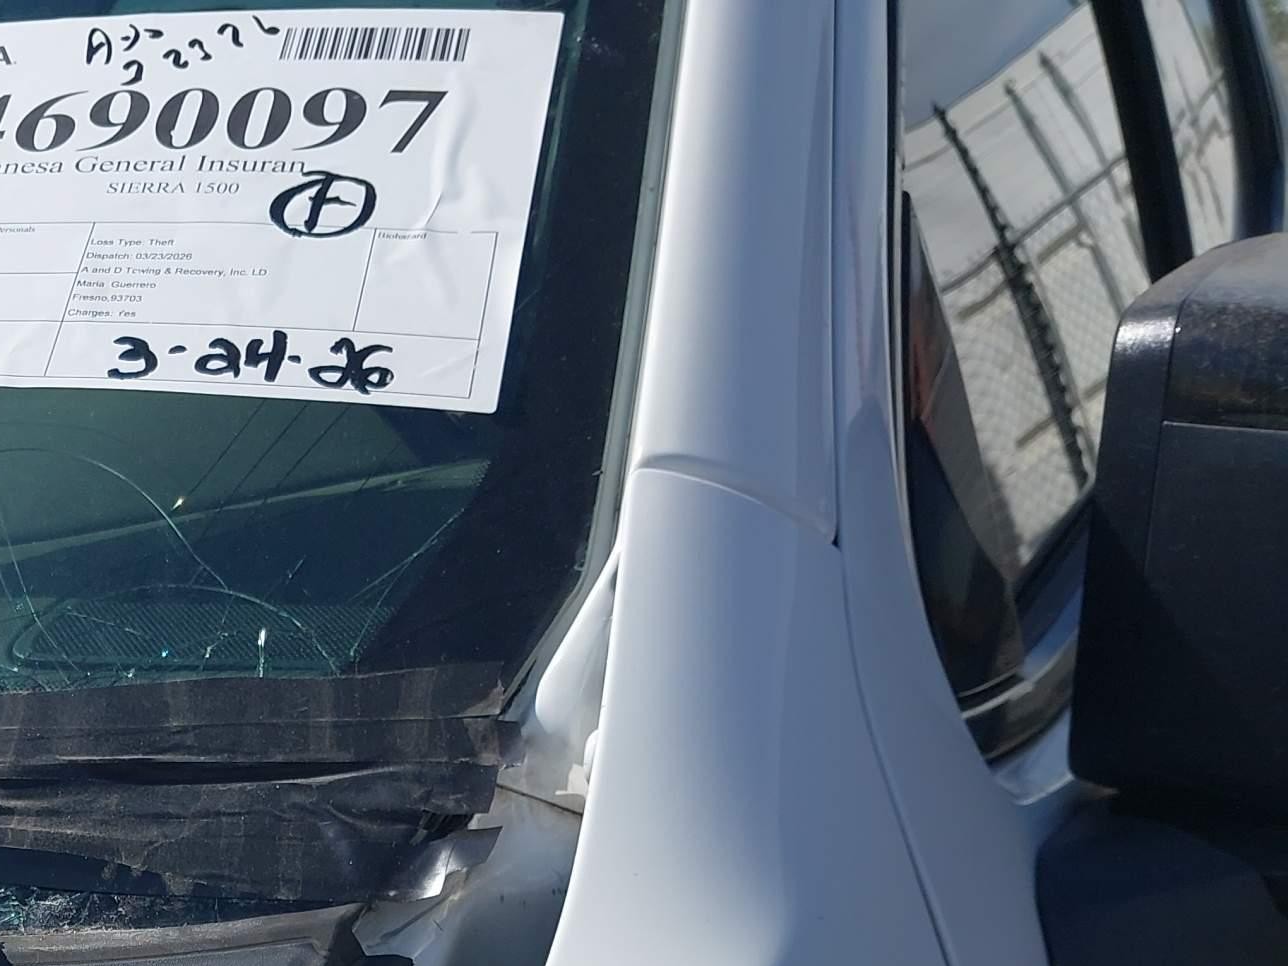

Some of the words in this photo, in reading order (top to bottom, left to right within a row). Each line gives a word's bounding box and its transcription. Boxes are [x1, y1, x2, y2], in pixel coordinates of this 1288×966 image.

[74, 155, 185, 173] General
[196, 155, 306, 174] Insuran
[106, 181, 186, 195] SIERRA
[194, 182, 240, 195] 1500
[90, 238, 115, 246] Loss
[118, 238, 145, 248] Type:
[149, 238, 175, 247] Theft
[85, 252, 130, 262] Dispatch:
[135, 252, 193, 261] 03/23/2026
[91, 266, 111, 275] and
[174, 267, 227, 278] Recovery,
[76, 280, 106, 288] Maria
[111, 281, 157, 289] Guerrero
[67, 308, 113, 318] Charges:
